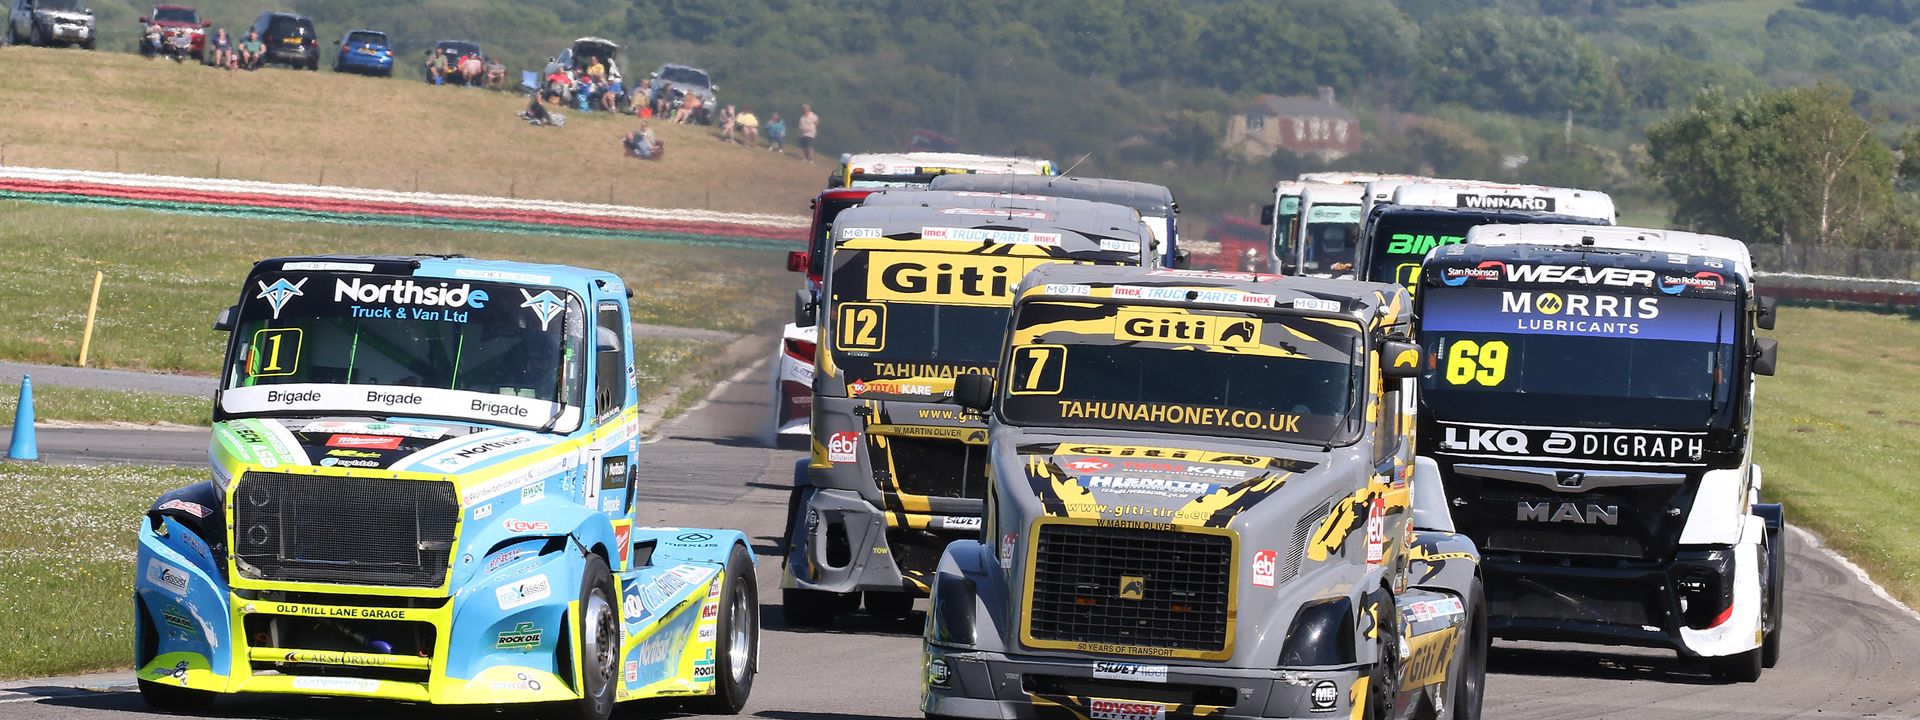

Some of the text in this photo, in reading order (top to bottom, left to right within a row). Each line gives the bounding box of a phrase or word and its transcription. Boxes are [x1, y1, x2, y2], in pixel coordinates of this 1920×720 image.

[1465, 196, 1547, 210] WINNARD
[844, 229, 881, 238] MOTIS
[923, 228, 1057, 245] imex TRUCK PARTS imex
[1101, 239, 1139, 252] MOTIS
[882, 262, 1008, 297] Giti
[1447, 267, 1499, 277] Stan Robinson
[1506, 263, 1656, 288] WEAVER
[1664, 275, 1717, 287] Stan Robinson
[334, 277, 490, 309] Northside
[1046, 285, 1089, 295] MOTIS
[1114, 286, 1141, 298] imex
[1195, 291, 1238, 303] PARTS
[1242, 293, 1271, 306] imex
[1294, 299, 1340, 311] MOTIS
[1501, 290, 1660, 319] MORRIS
[351, 305, 468, 323] Truck & Van Ltd
[844, 308, 878, 346] 12
[1124, 316, 1206, 341] Giti
[1517, 318, 1640, 335] LUBRICANTS
[263, 334, 283, 372] 1
[1026, 349, 1050, 390] 7
[1445, 339, 1509, 388] 69
[267, 390, 322, 406] Brigade
[869, 383, 901, 394] TOTAL
[901, 384, 932, 396] KARE
[366, 390, 423, 407] Brigade
[471, 400, 528, 418] Brigade
[1058, 399, 1301, 433] TAHUNAHONEY.CO.UK
[894, 426, 962, 438] W.MARTIN OLIVER
[828, 432, 858, 454] febi
[1444, 427, 1703, 458] LKQ DIGRAPH
[1069, 445, 1195, 459] Giti
[1186, 465, 1248, 477] KARE
[1067, 502, 1212, 521] www.giti-tire.eu
[1516, 501, 1619, 526] MAN
[1096, 519, 1177, 532] W.MARTIN OLIVER
[1252, 550, 1276, 576] febi
[276, 604, 405, 619] OLD MILL LANE GARAGE
[499, 634, 540, 644] ROCK OIL
[1089, 644, 1114, 652] YEARS
[1115, 645, 1126, 653] OF
[1128, 646, 1174, 657] TRANSPORT
[1409, 642, 1437, 683] Giti
[1315, 686, 1336, 699] MEI
[1092, 700, 1161, 716] ODYSSEY
[1092, 712, 1157, 720] BATTERY
